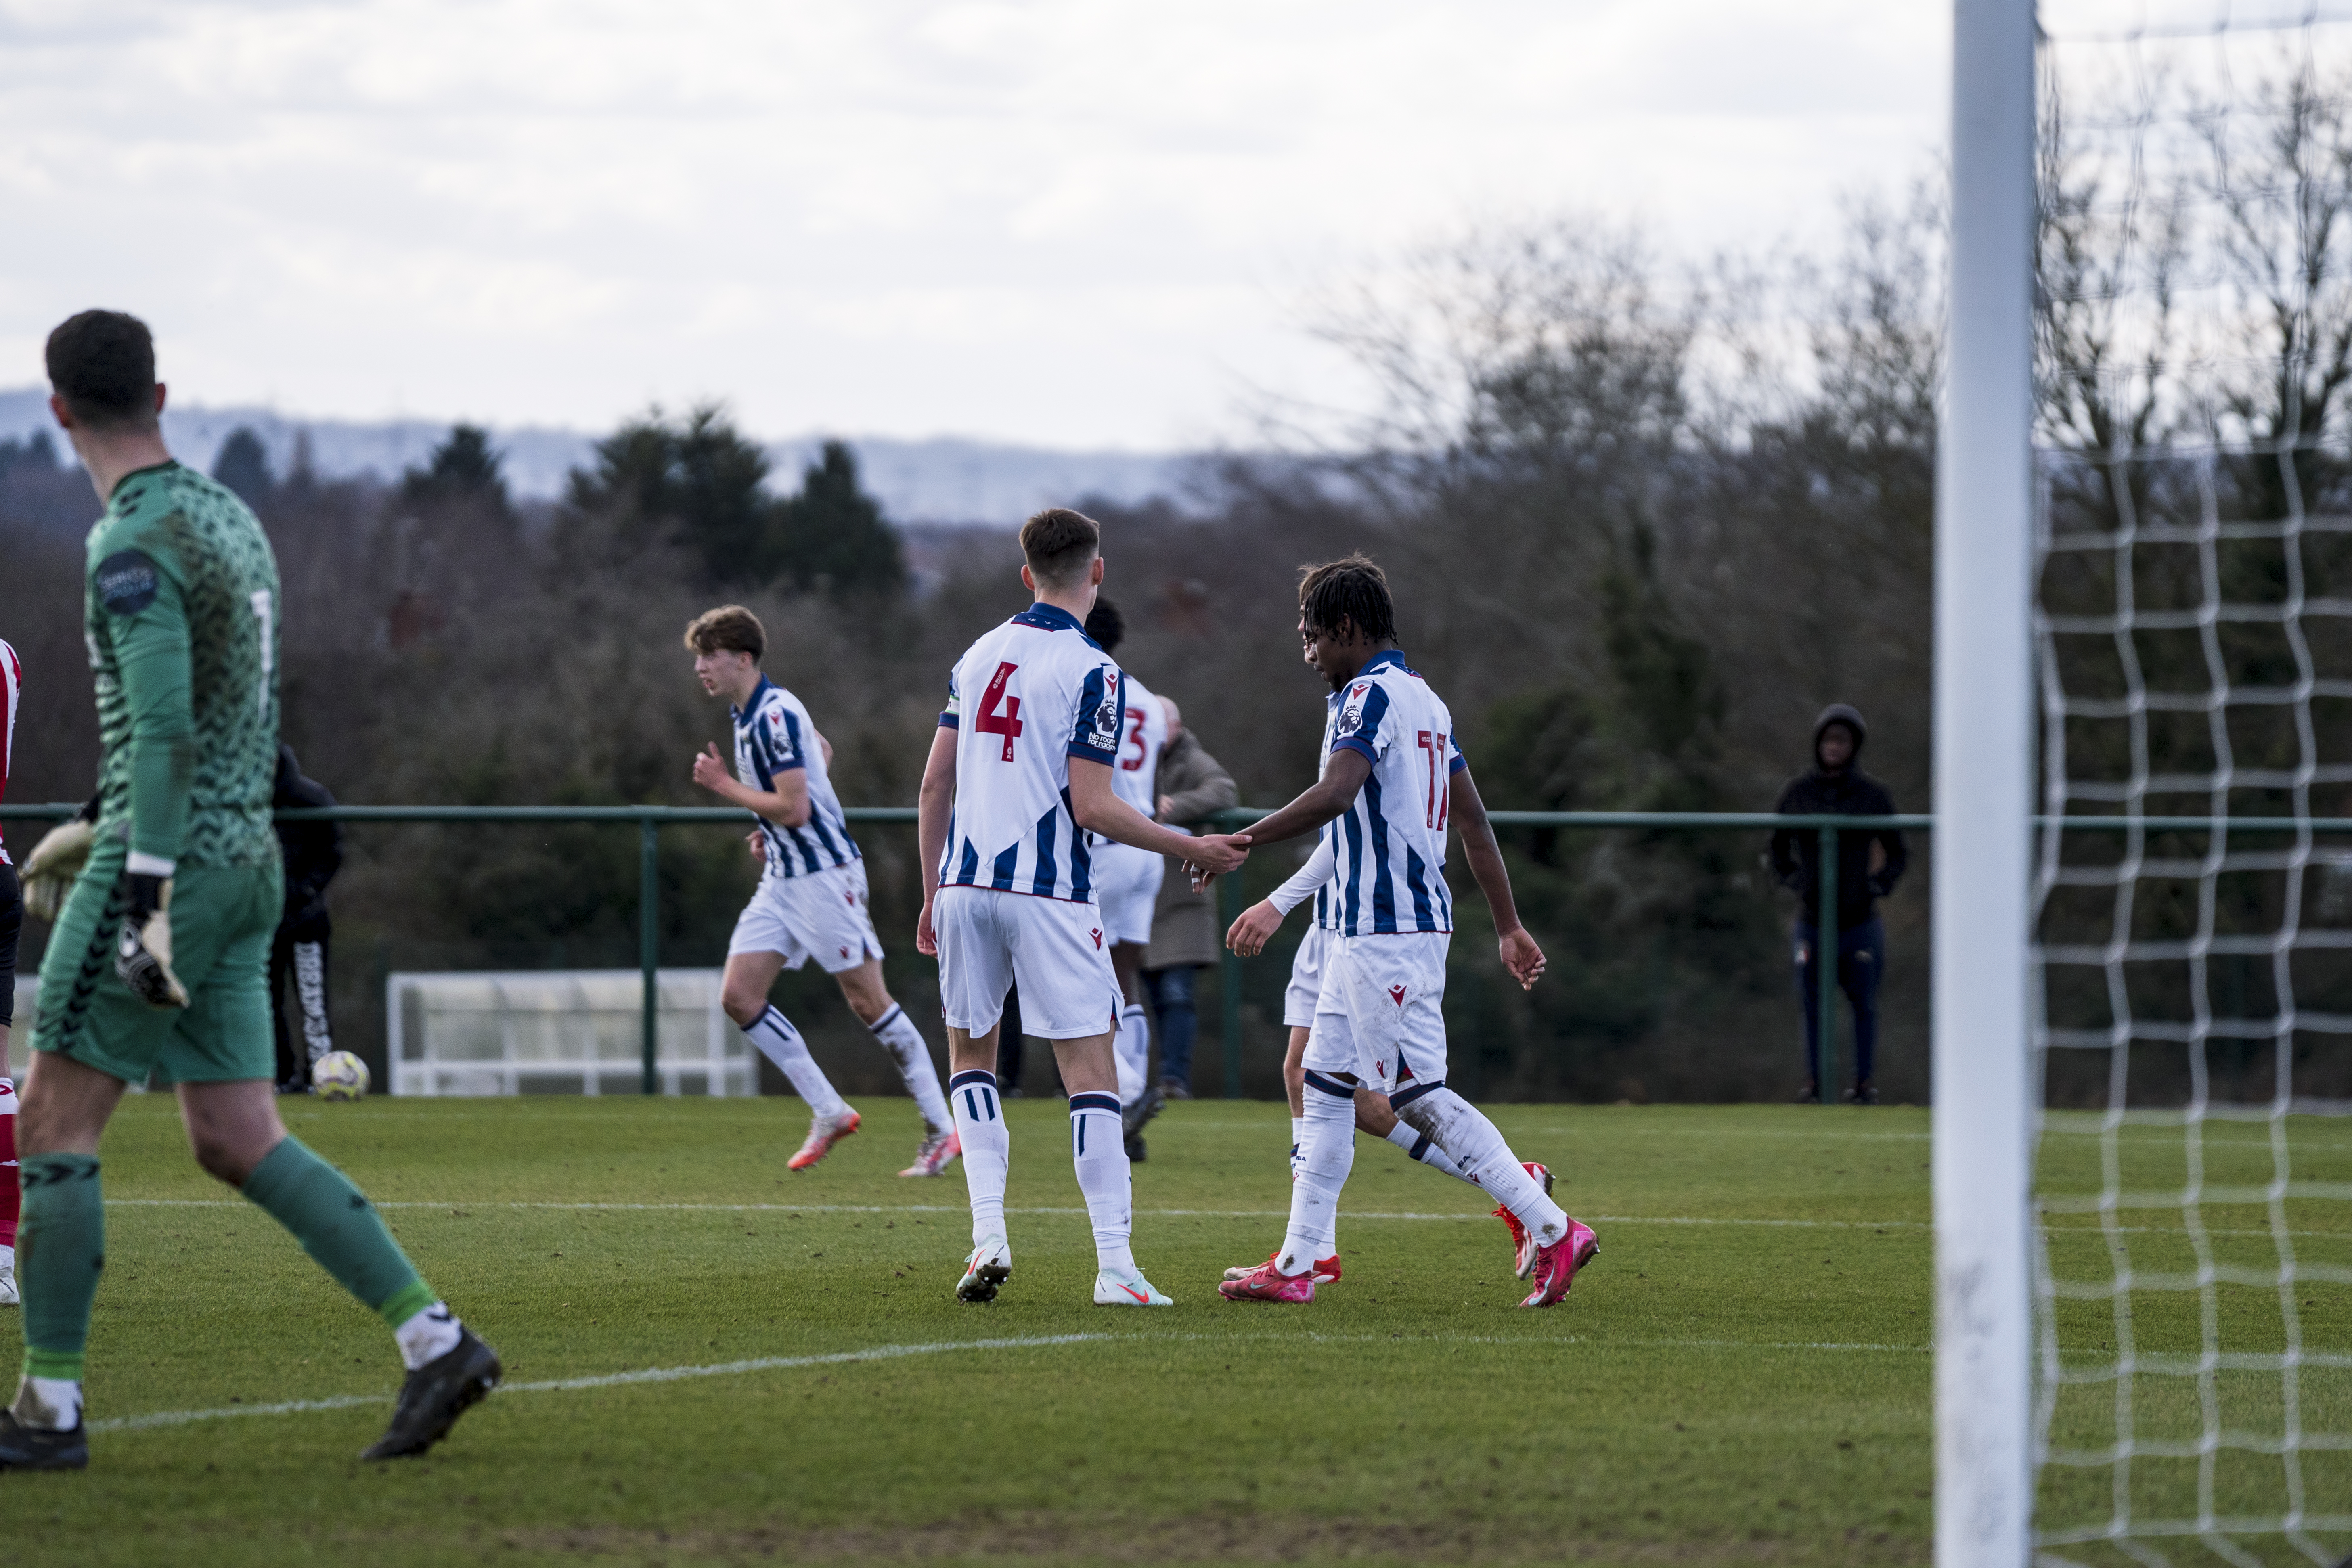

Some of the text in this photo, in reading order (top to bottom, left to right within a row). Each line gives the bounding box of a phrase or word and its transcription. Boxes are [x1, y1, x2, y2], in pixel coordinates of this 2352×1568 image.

[250, 590, 273, 726] 1
[975, 661, 1023, 762] 4
[1088, 737, 1098, 746] for
[1089, 732, 1116, 745] No room
[1121, 707, 1146, 771] 3
[1418, 730, 1447, 831] 11
